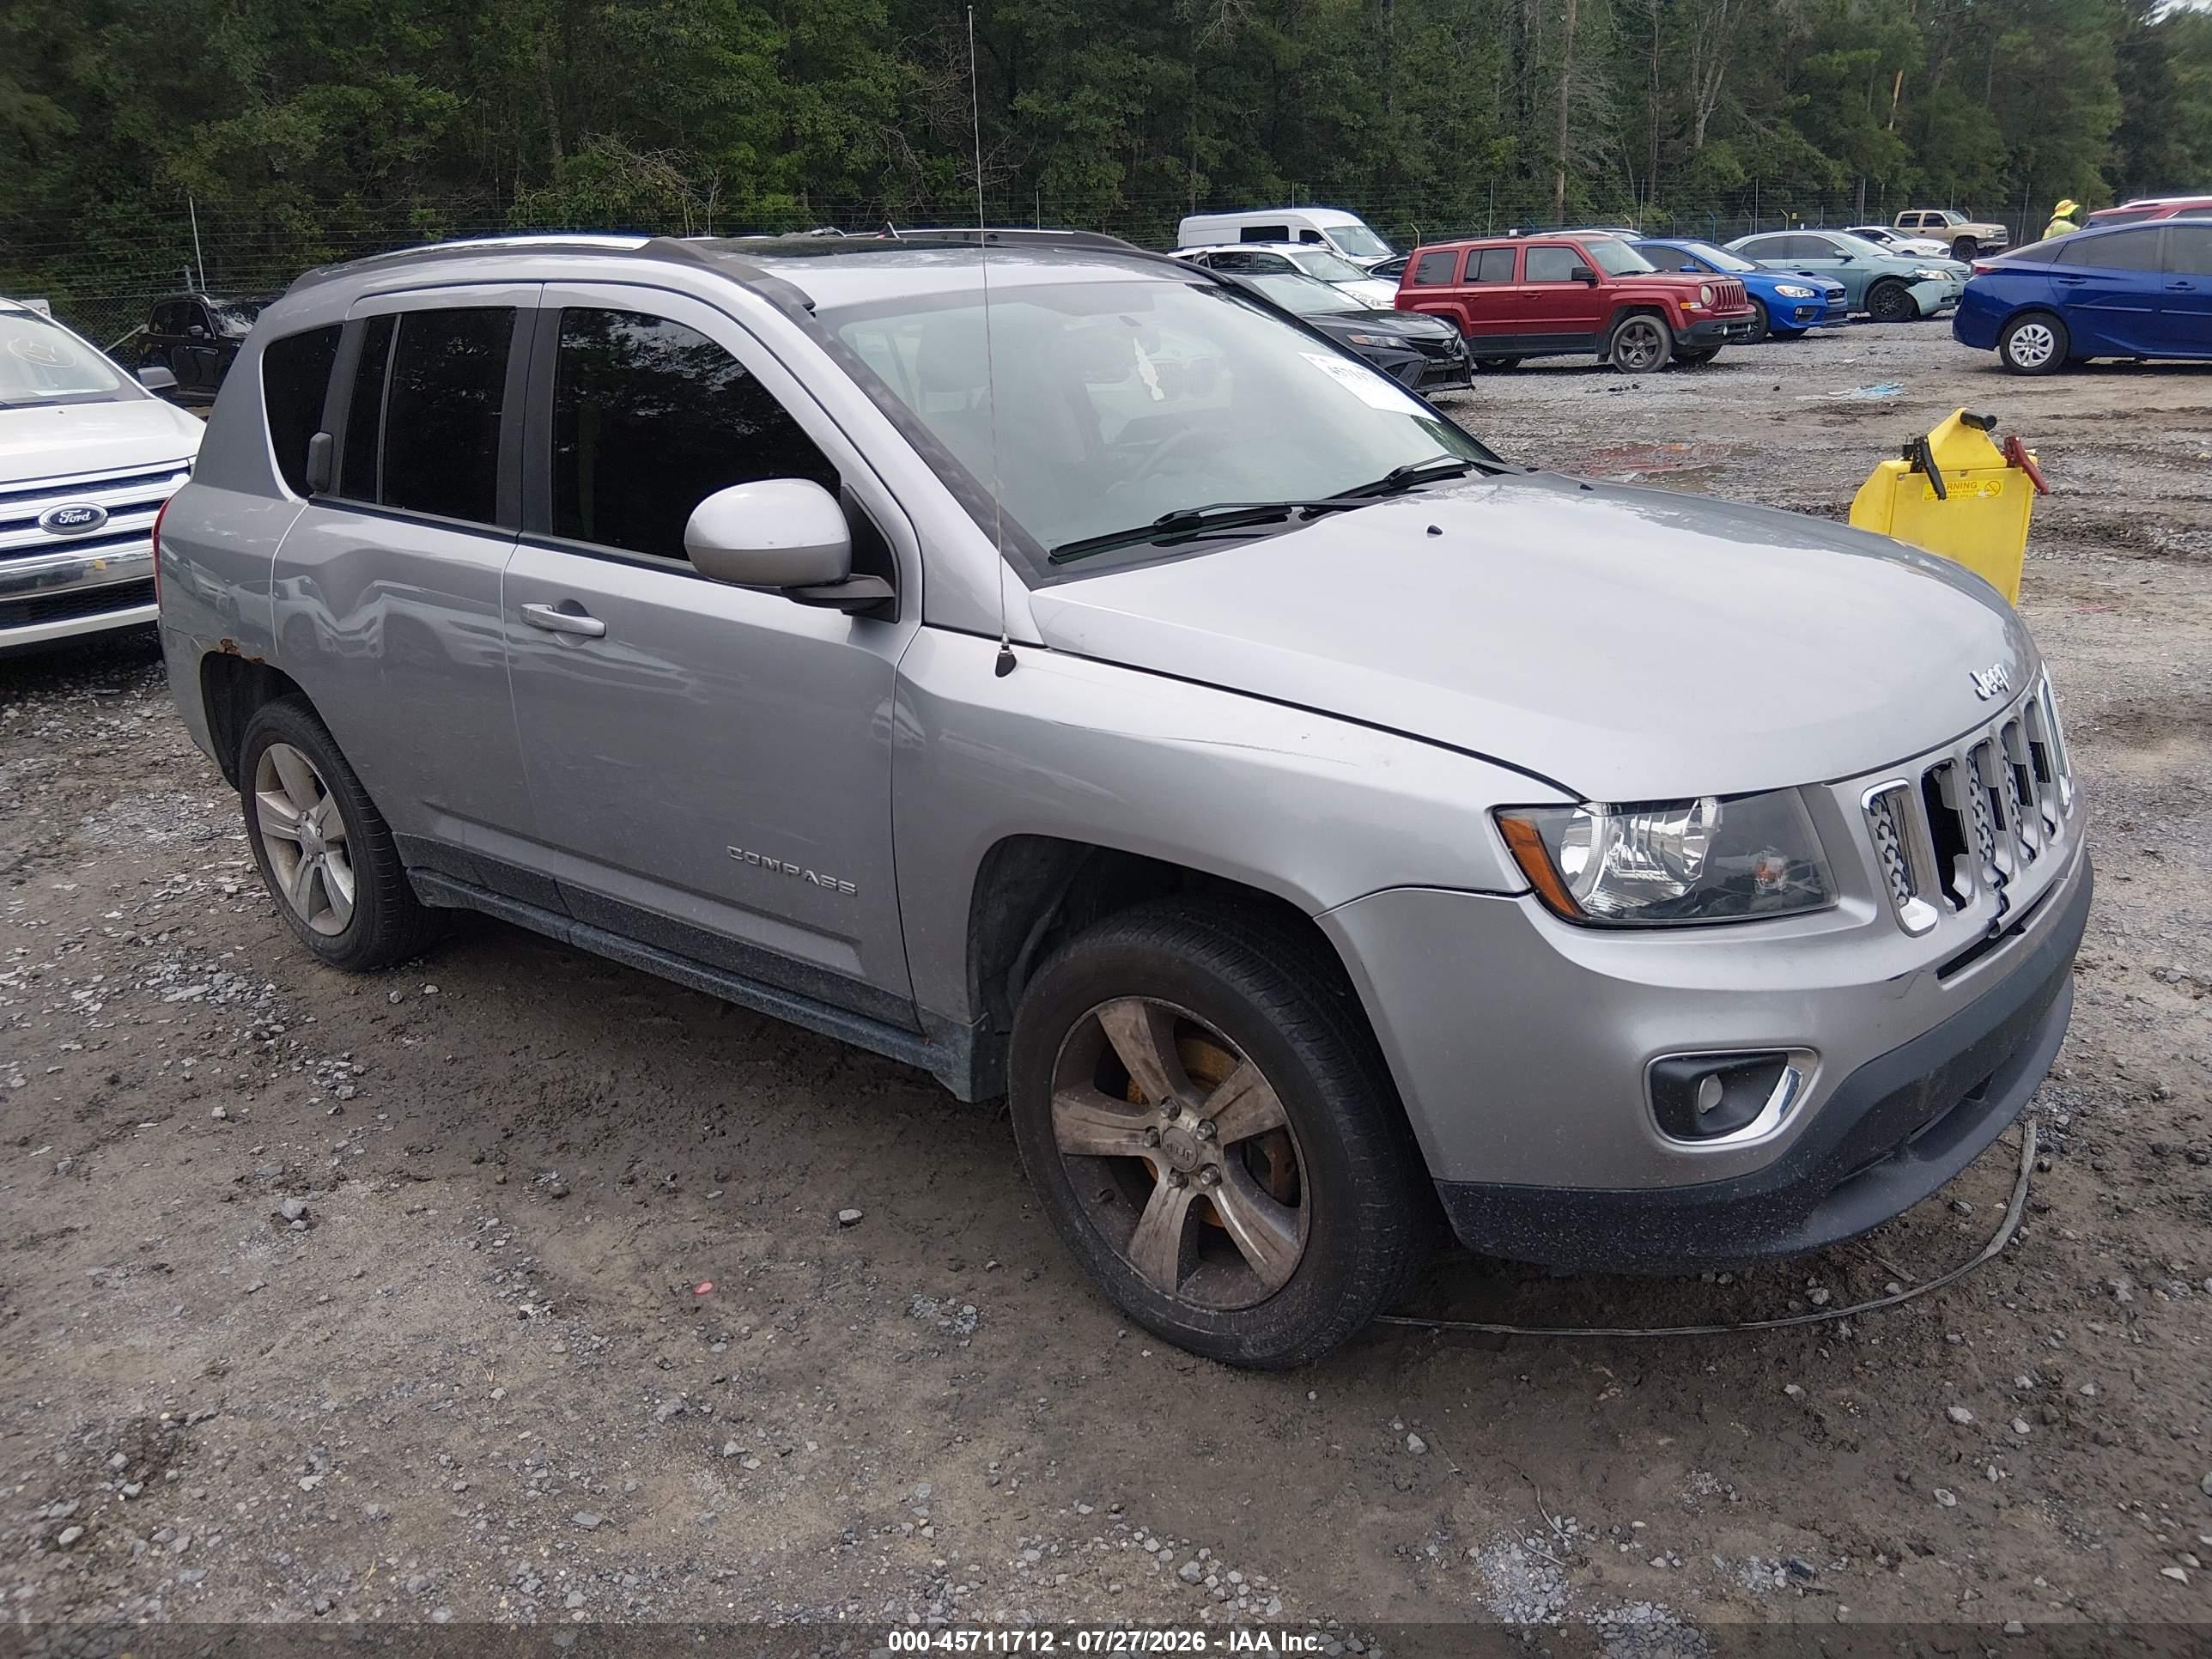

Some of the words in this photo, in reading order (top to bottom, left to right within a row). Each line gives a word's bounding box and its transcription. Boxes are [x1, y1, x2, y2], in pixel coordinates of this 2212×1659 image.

[1946, 482, 1978, 490] RNING
[58, 509, 92, 524] Ford
[1970, 663, 2010, 701] Jeep
[727, 845, 858, 896] COMPASS
